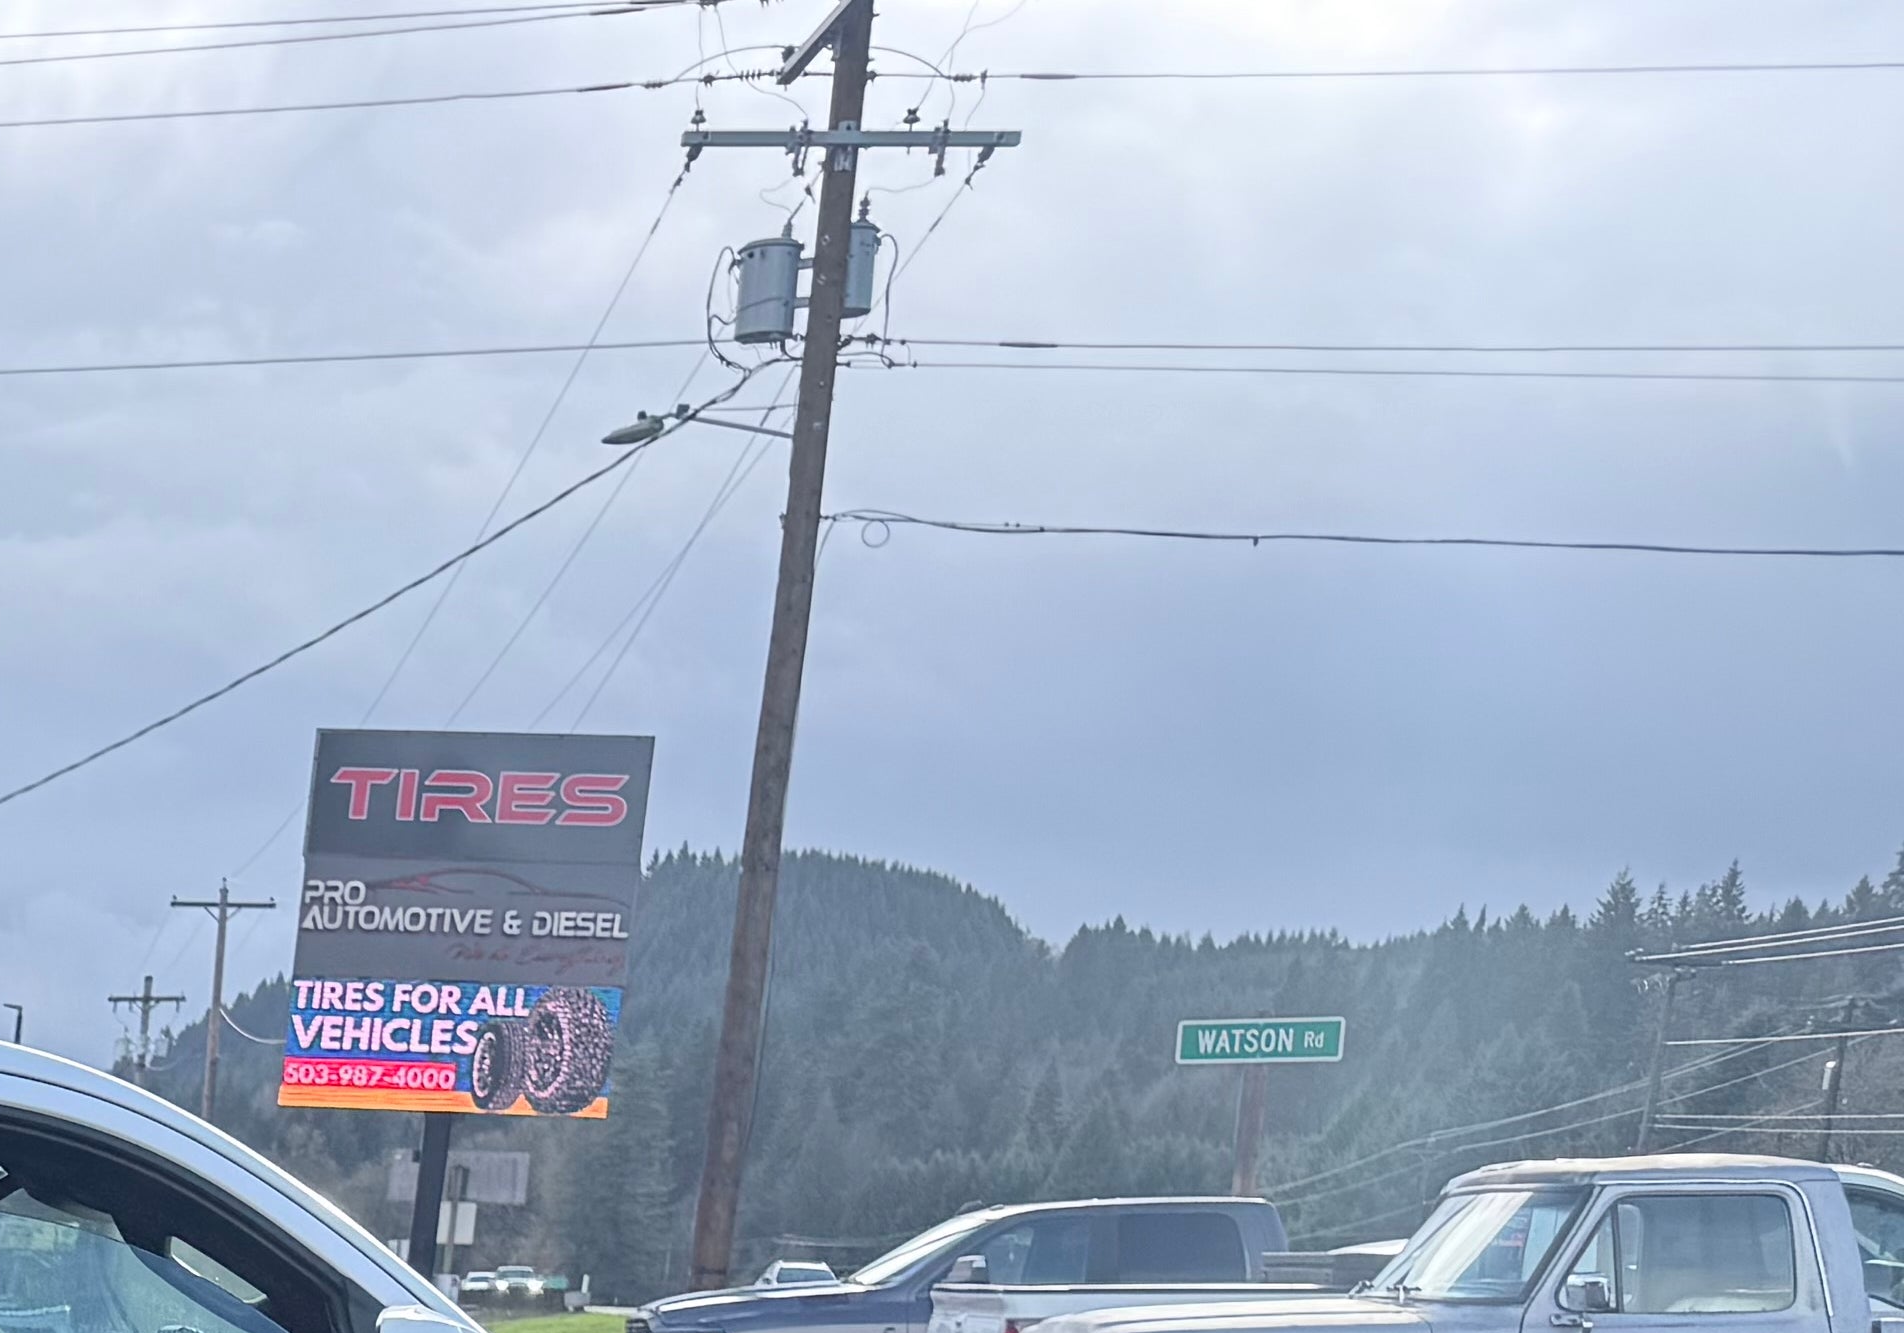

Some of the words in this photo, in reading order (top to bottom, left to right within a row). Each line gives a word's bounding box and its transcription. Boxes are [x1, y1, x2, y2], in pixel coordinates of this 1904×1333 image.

[330, 767, 630, 827] TIRES
[304, 879, 366, 905] PRO
[301, 904, 492, 935] AUTOMOTIVE
[502, 910, 522, 936] &
[532, 910, 629, 939] DIESEL
[293, 980, 384, 1011] TIRES
[393, 983, 462, 1015] FOR
[467, 985, 530, 1018] ALL
[292, 1014, 479, 1055] VEHICLES
[1198, 1028, 1294, 1055] WATSON
[1304, 1031, 1324, 1049] Rd
[283, 1063, 456, 1090] 503-987-4000
